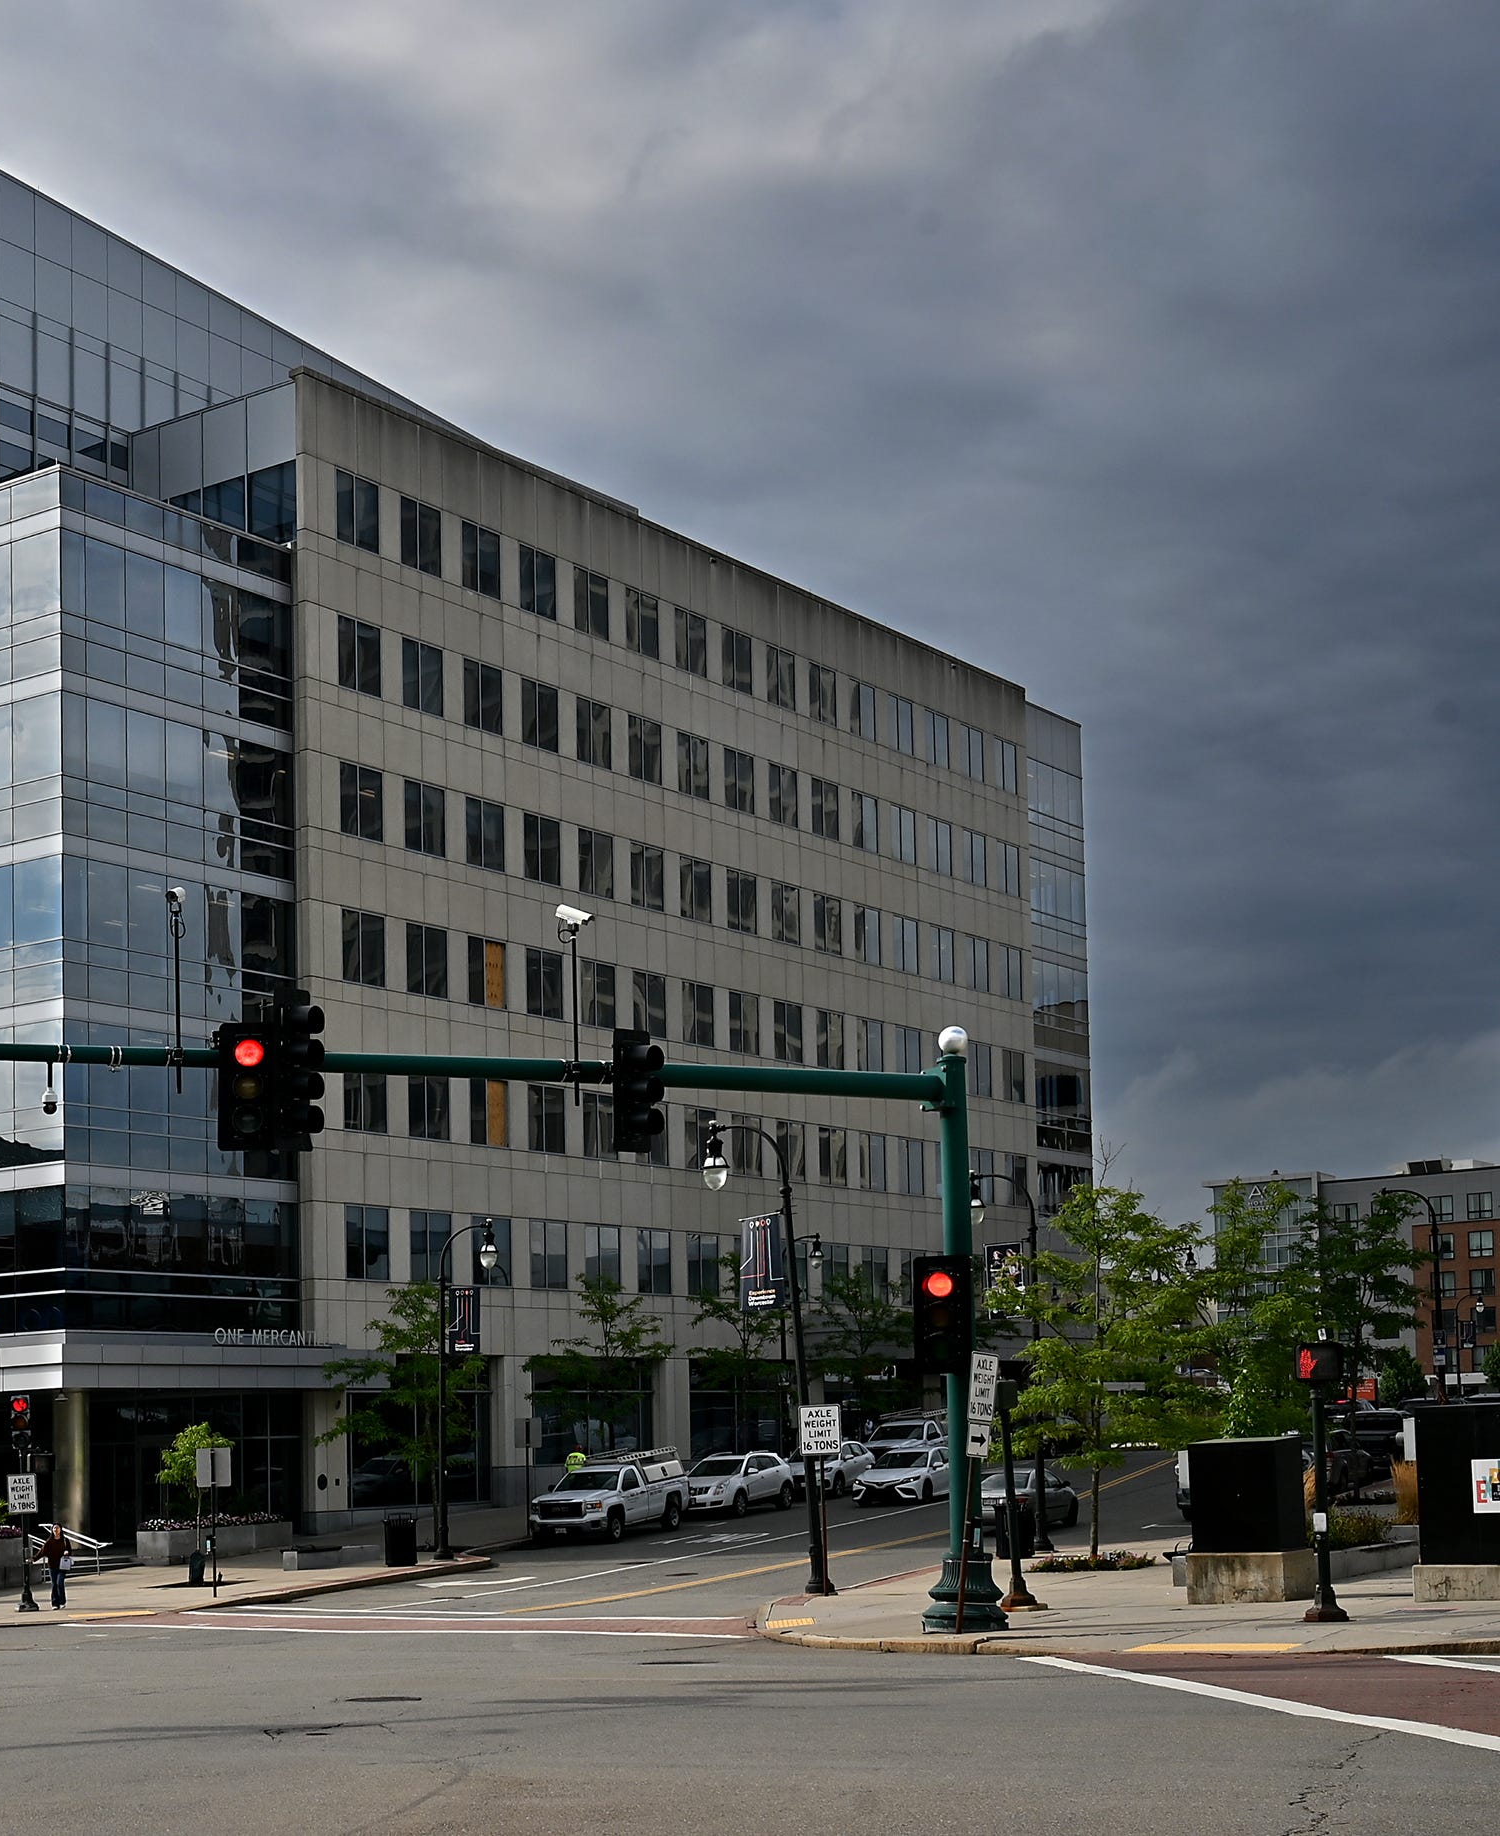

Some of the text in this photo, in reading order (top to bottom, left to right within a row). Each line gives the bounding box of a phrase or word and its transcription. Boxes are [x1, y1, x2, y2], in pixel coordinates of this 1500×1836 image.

[214, 1327, 245, 1345] ONE
[976, 1359, 994, 1371] AXLE
[973, 1372, 995, 1385] WEIGHT
[975, 1386, 991, 1399] LIMIT
[807, 1409, 832, 1418] AXLE
[970, 1401, 993, 1417] 16 TONS
[804, 1419, 837, 1428] WEIGHT
[808, 1429, 832, 1438] LIMIT
[803, 1440, 839, 1451] 16 TONS
[13, 1477, 31, 1485] AXLE
[10, 1485, 33, 1493] WEIGHT
[13, 1493, 30, 1501] LIMIT
[10, 1501, 36, 1510] 16 TONS
